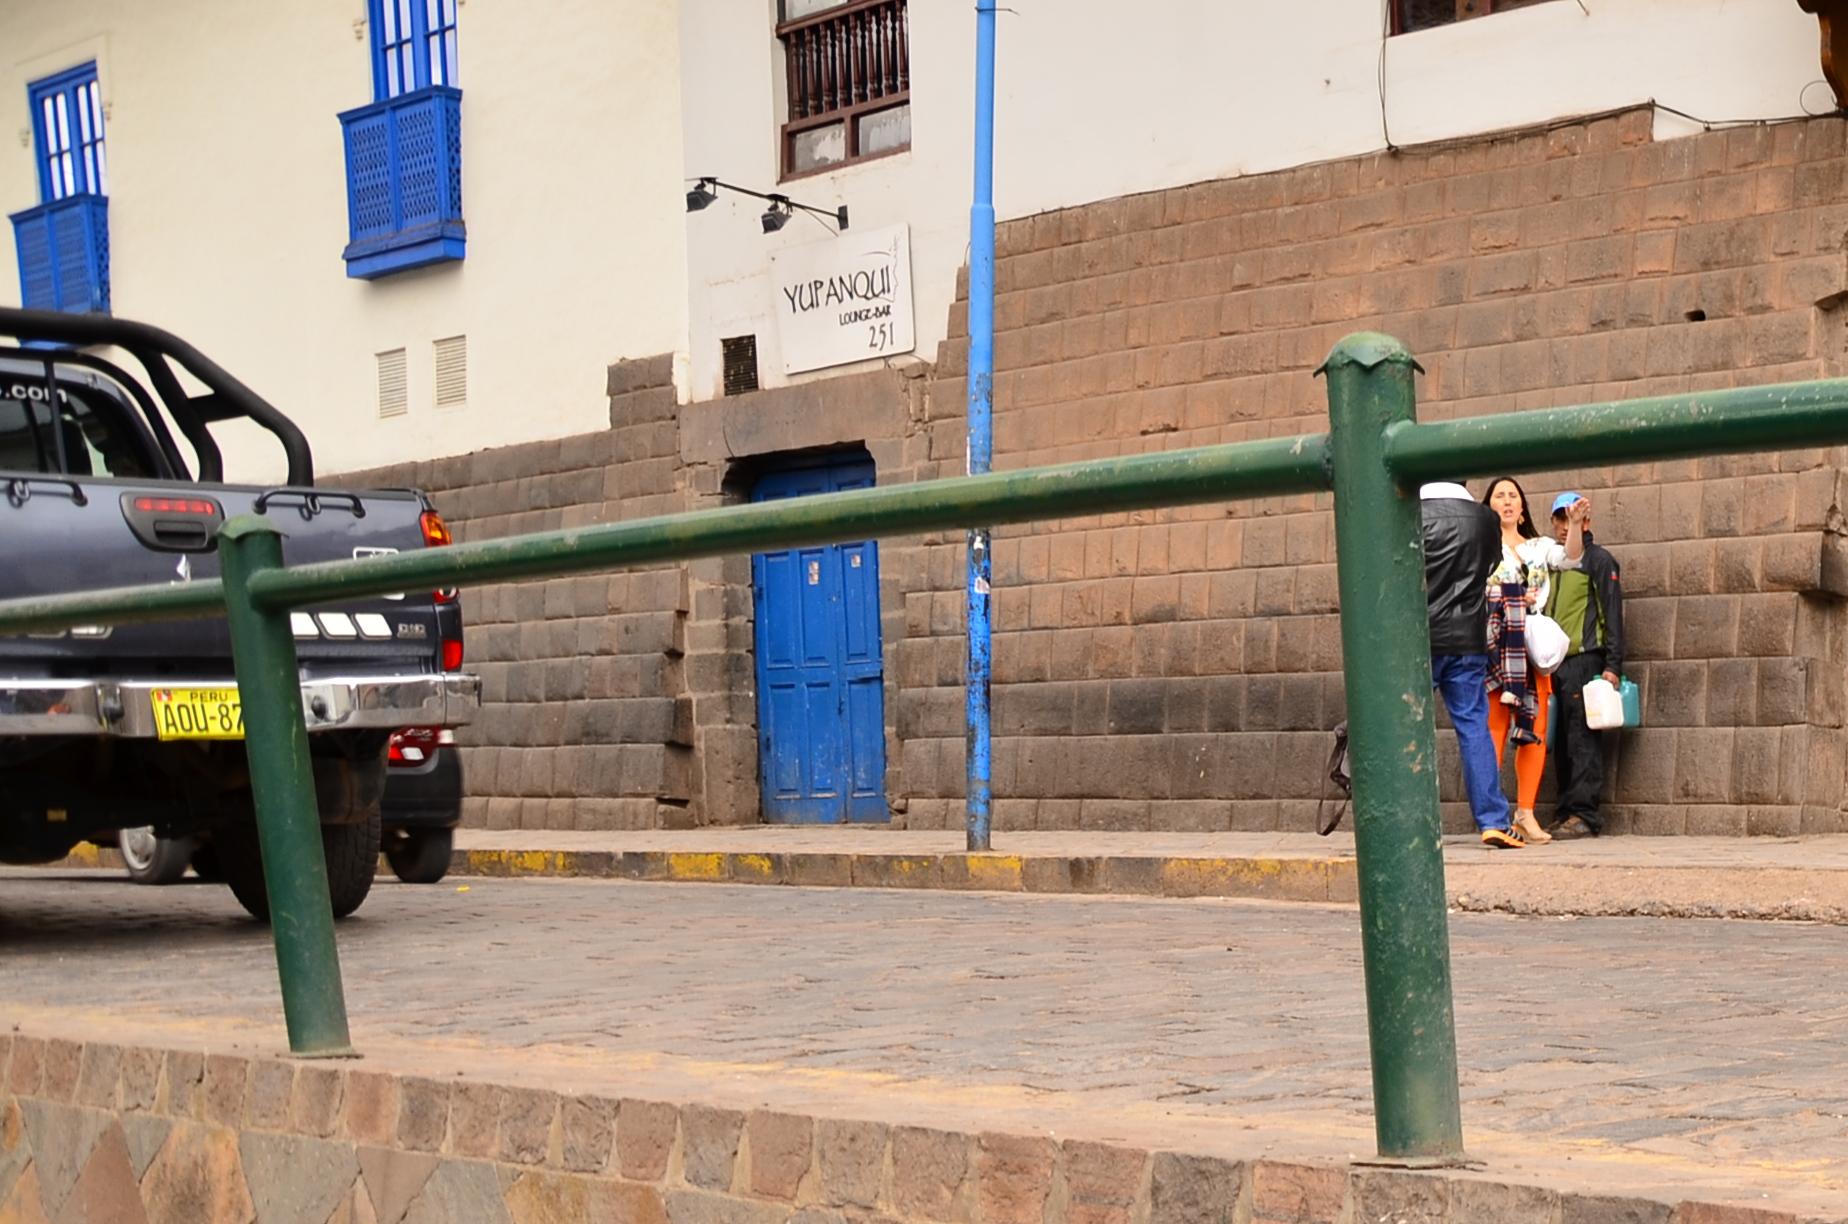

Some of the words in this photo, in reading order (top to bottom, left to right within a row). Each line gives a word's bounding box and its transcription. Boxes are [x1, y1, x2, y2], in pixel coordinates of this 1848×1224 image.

[783, 265, 891, 314] YUPANQUI
[868, 321, 894, 351] 251
[0, 384, 68, 403] .com
[190, 692, 228, 702] PERU
